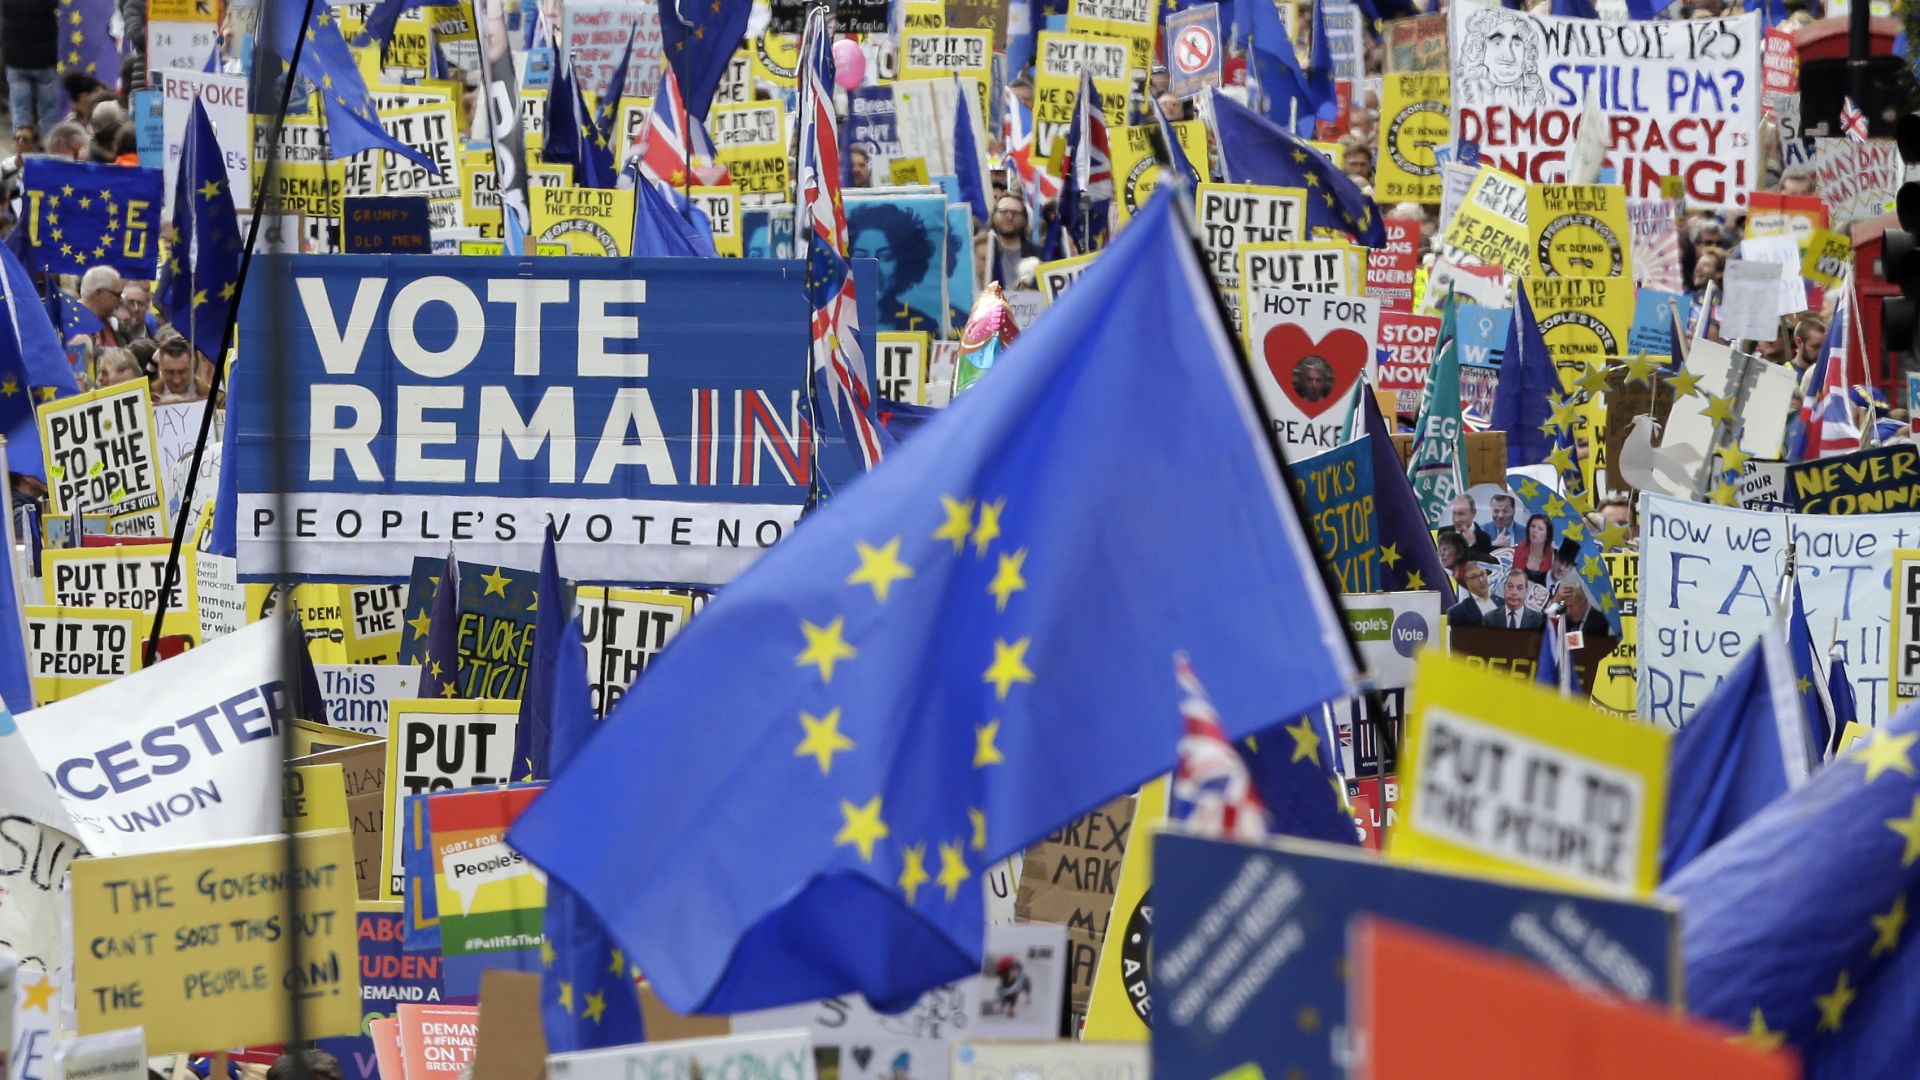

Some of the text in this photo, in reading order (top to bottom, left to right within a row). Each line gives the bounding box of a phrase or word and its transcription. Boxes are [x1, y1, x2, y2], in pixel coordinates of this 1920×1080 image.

[1078, 2, 1148, 22] THE PEOPLE
[439, 20, 469, 35] VOTE
[1688, 20, 1741, 60] 125
[911, 37, 983, 53] PUT IT TO
[1048, 41, 1123, 66] PUT IT TO
[910, 54, 983, 67] THE PEOPLE
[1047, 60, 1073, 74] THE
[165, 77, 245, 108] REVOKE
[1040, 88, 1060, 103] WE
[1550, 64, 1744, 113] STILL PM?
[733, 110, 776, 129] IT TO
[1038, 106, 1048, 117] A
[293, 126, 309, 145] IT
[424, 114, 446, 142] IT
[723, 127, 776, 145] PEOPLE
[1459, 105, 1726, 156] DEMORACY
[1731, 131, 1751, 149] IS
[285, 146, 333, 161] PEOPLE
[280, 177, 341, 197] DEMAND
[544, 189, 613, 206] PUT IT TO
[1483, 174, 1517, 197] PUT
[1542, 186, 1607, 201] PUT IT TO
[1827, 170, 1891, 205] MAYDAY
[545, 203, 612, 218] THE PEOPLE
[709, 197, 729, 218] TO
[1206, 194, 1293, 227] PUT IT
[1477, 189, 1499, 212] THE
[1544, 200, 1608, 212] THE PEOPLE
[353, 208, 410, 224] GRUMPY
[354, 234, 423, 249] OLD MEN
[1204, 222, 1235, 249] TO
[1457, 212, 1530, 260] WE DEMAN
[1448, 229, 1532, 277] A PEOPLE'S
[1555, 244, 1603, 254] WE DEMAND
[1250, 254, 1339, 283] PUT IT
[1533, 279, 1607, 295] PUT IT TO
[1264, 293, 1367, 325] HOT FOR
[1533, 295, 1605, 308] THE PEOPLE
[295, 275, 649, 379] VOTE
[1383, 324, 1438, 343] STOP
[1589, 318, 1616, 350] VOTE
[1560, 343, 1598, 355] DEMAND
[1378, 365, 1431, 384] NOW
[51, 395, 140, 451] PUT IT
[308, 383, 813, 487] REMAIN
[1274, 419, 1344, 448] PEAKE
[54, 431, 147, 483] TO THE
[58, 463, 151, 512] PEOPLE
[1792, 452, 1919, 501] NEVER
[138, 494, 159, 510] VOTE
[253, 508, 783, 549] PEOPLE'S VOTE NO
[1649, 510, 1878, 559] now we have
[57, 563, 107, 593] PUT
[117, 561, 142, 591] IT
[197, 579, 235, 591] emocrats
[104, 587, 184, 611] PEOPE
[353, 585, 404, 616] PUT
[355, 610, 397, 635] THE
[635, 609, 675, 650] IT
[1396, 626, 1425, 642] Vote
[56, 622, 127, 653] IT TO
[457, 612, 538, 668] EVOKE
[1657, 619, 1741, 659] give
[39, 651, 126, 676] PEOPLE
[322, 670, 376, 696] This
[404, 721, 498, 775] PUT
[1427, 722, 1509, 792] PUT
[1523, 756, 1562, 814] IT
[1582, 774, 1634, 835] TO
[108, 779, 223, 834] UNION
[440, 834, 498, 856] LGBT+ FOR
[1420, 781, 1480, 836] THE
[1493, 804, 1625, 884] PEOPLE
[453, 850, 523, 879] People's
[101, 874, 177, 915] THE
[90, 932, 157, 960] CAN'T
[173, 922, 224, 953] SORT
[229, 914, 282, 943] THIS
[464, 932, 547, 952] #PutItToThe
[92, 964, 269, 1016] THE PEOPLE
[426, 986, 441, 1003] A
[422, 1035, 432, 1046] A
[424, 1045, 456, 1062] ON
